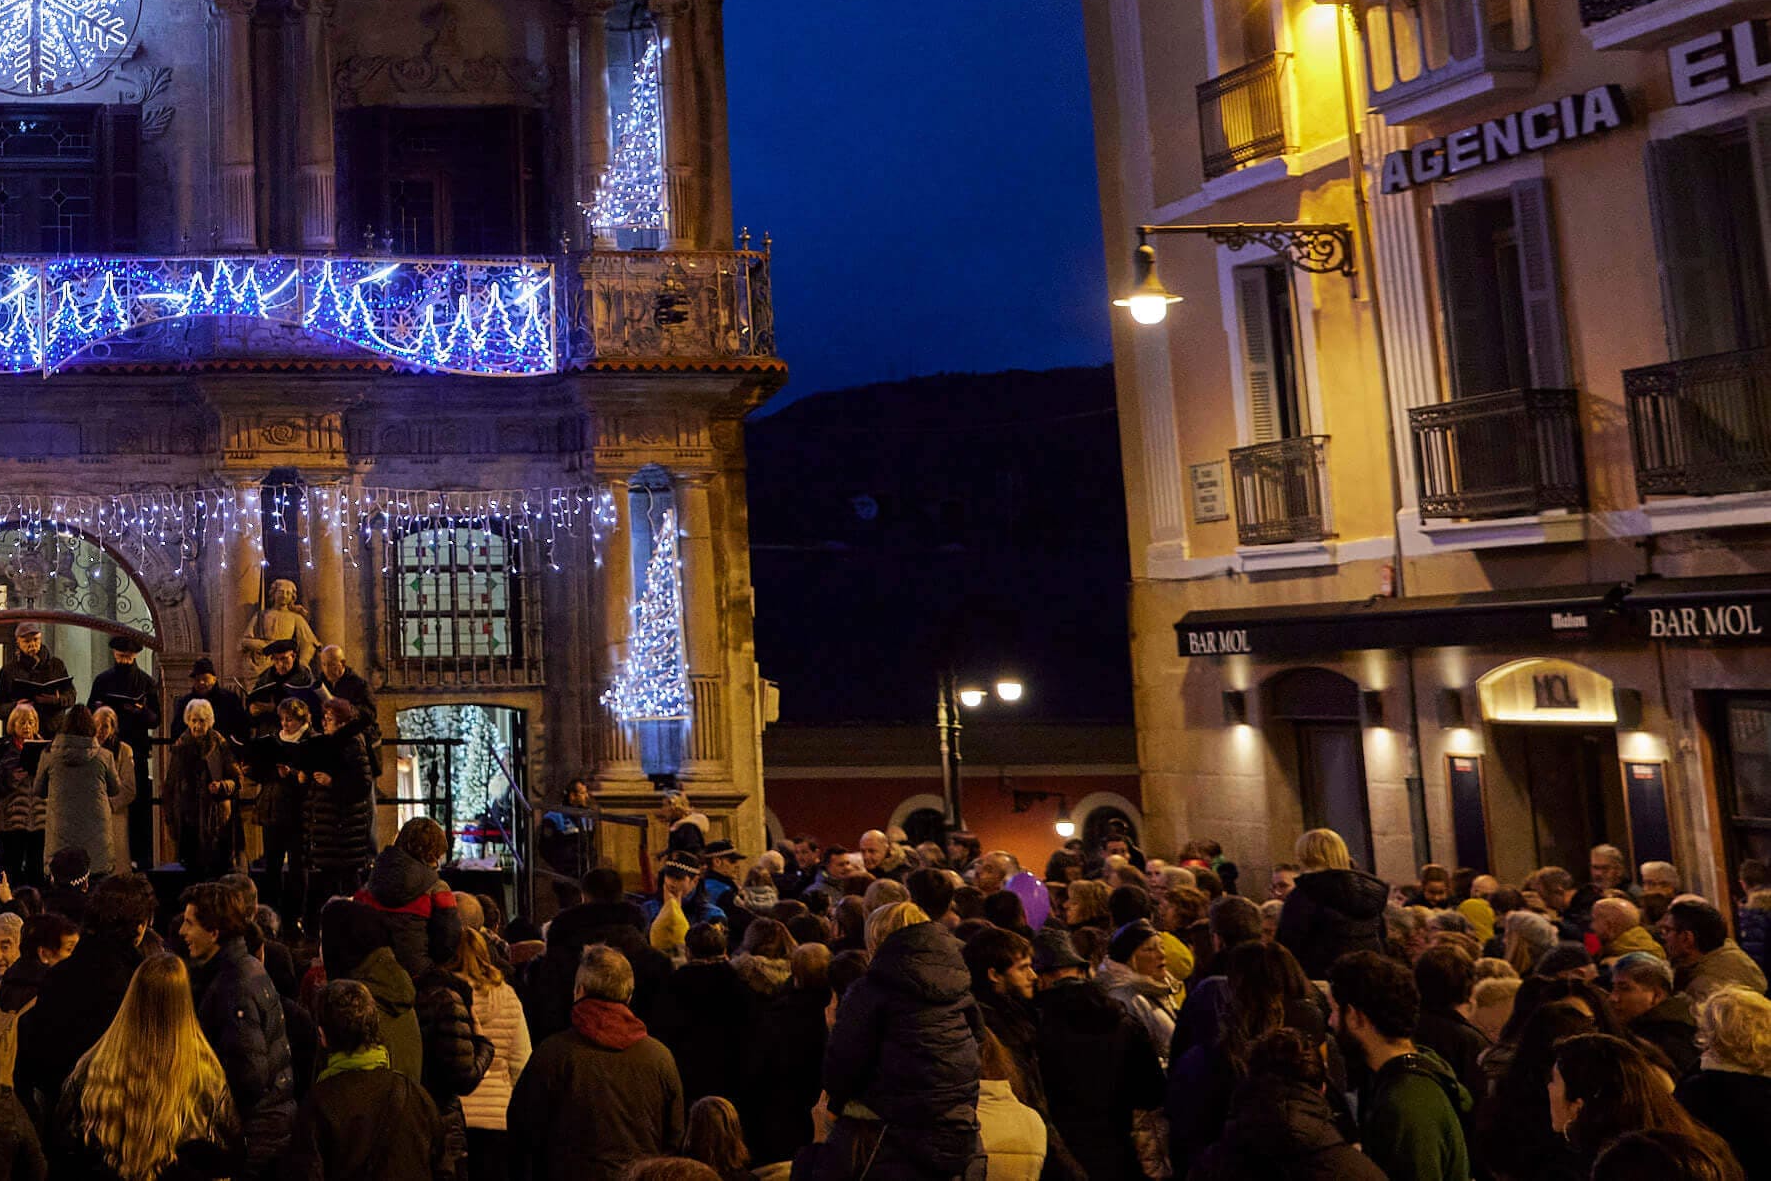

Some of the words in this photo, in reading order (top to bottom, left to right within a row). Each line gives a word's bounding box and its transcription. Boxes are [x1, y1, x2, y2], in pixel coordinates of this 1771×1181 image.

[1381, 85, 1622, 195] AGENCIA
[1649, 608, 1701, 637] BAR
[1702, 604, 1764, 636] MOL
[1188, 630, 1218, 654] BAR
[1218, 629, 1252, 653] MOL
